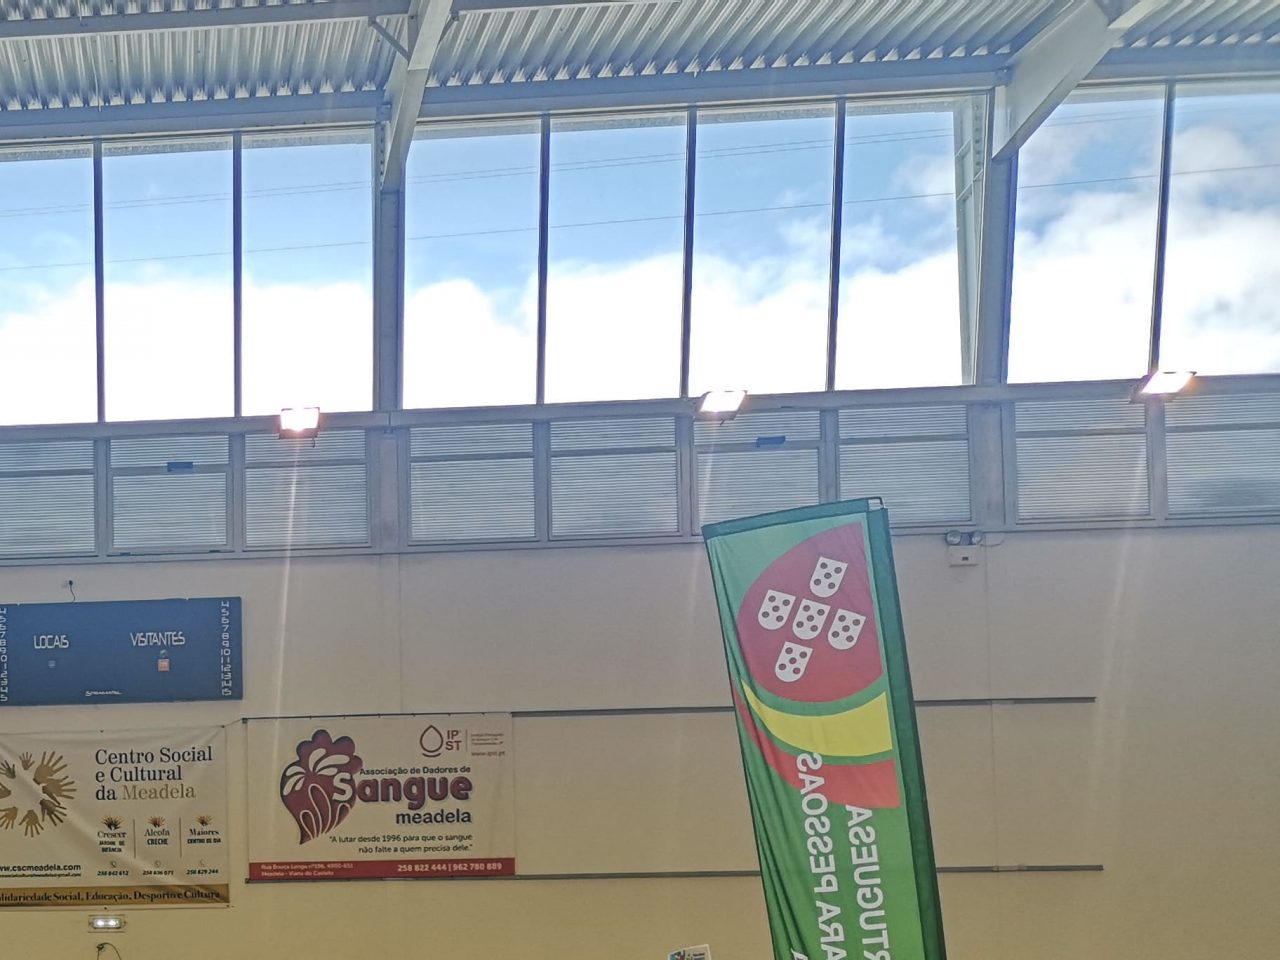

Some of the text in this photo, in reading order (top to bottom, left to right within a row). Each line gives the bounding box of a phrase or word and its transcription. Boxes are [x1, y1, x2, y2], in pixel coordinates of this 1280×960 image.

[0, 615, 6, 623] 5
[221, 616, 229, 624] 6
[130, 631, 186, 647] VISITANTES
[222, 632, 230, 640] 8
[34, 635, 70, 649] LOCAIS
[222, 640, 230, 648] 9
[221, 664, 231, 672] 12
[221, 672, 231, 680] 13
[221, 688, 232, 696] 15
[447, 730, 459, 740] IP
[445, 740, 462, 751] ST
[95, 746, 213, 765] Centro Social
[95, 765, 183, 783] e Cultural
[360, 767, 409, 777] Associação
[422, 766, 458, 774] Dadores
[96, 784, 197, 800] da Meadela
[332, 772, 473, 810] Sangue
[396, 808, 472, 824] meadela
[421, 835, 436, 843] que
[445, 834, 473, 842] sangue
[358, 846, 373, 854] não
[423, 845, 451, 853] precisa
[398, 864, 413, 872] 258
[414, 864, 429, 872] 822
[430, 863, 447, 871] 444
[452, 863, 469, 871] 962
[469, 863, 485, 871] 780
[486, 862, 503, 870] 889
[133, 891, 177, 902] Desporto
[183, 890, 220, 899] Cultura
